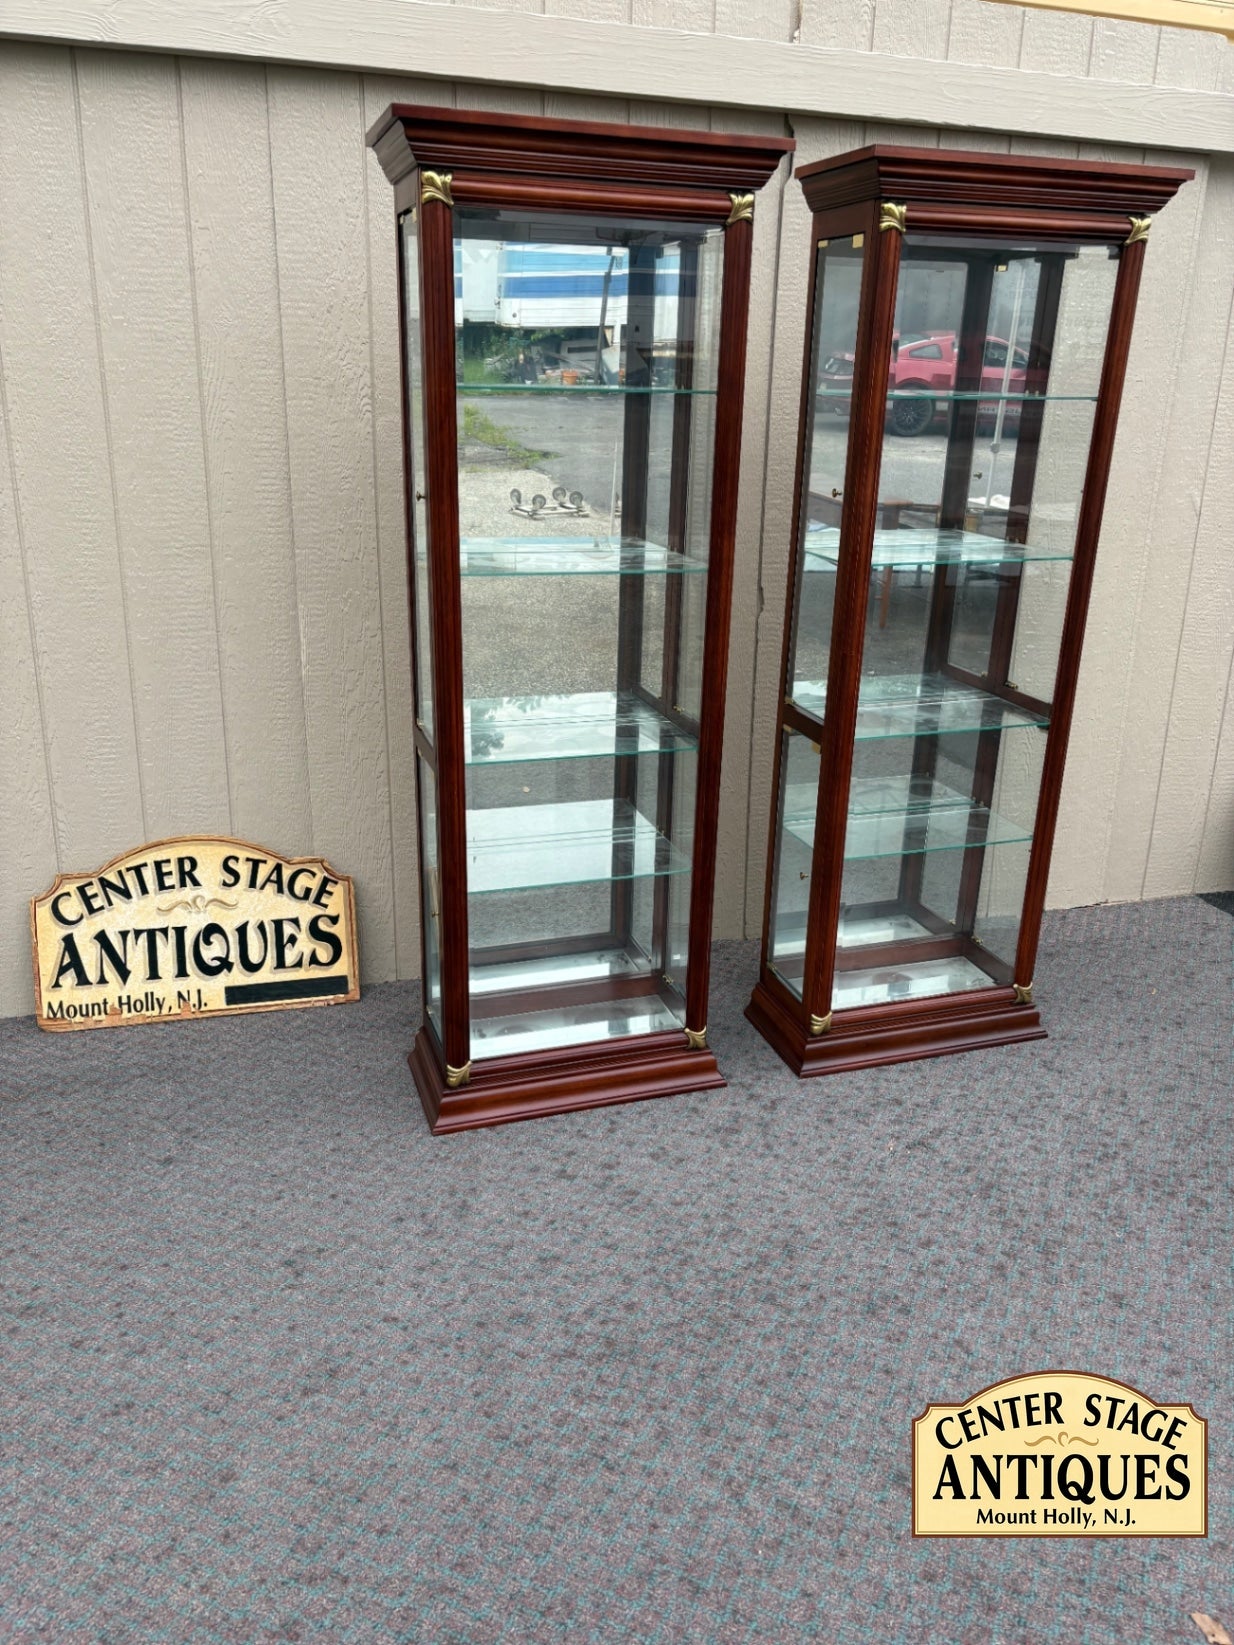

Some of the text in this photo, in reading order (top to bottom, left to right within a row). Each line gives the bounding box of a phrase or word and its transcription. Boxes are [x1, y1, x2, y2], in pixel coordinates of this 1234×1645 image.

[50, 855, 338, 926] CENTER STAGE
[51, 913, 342, 988] ANTIQUES
[46, 989, 207, 1019] Mount Holly, N.J.
